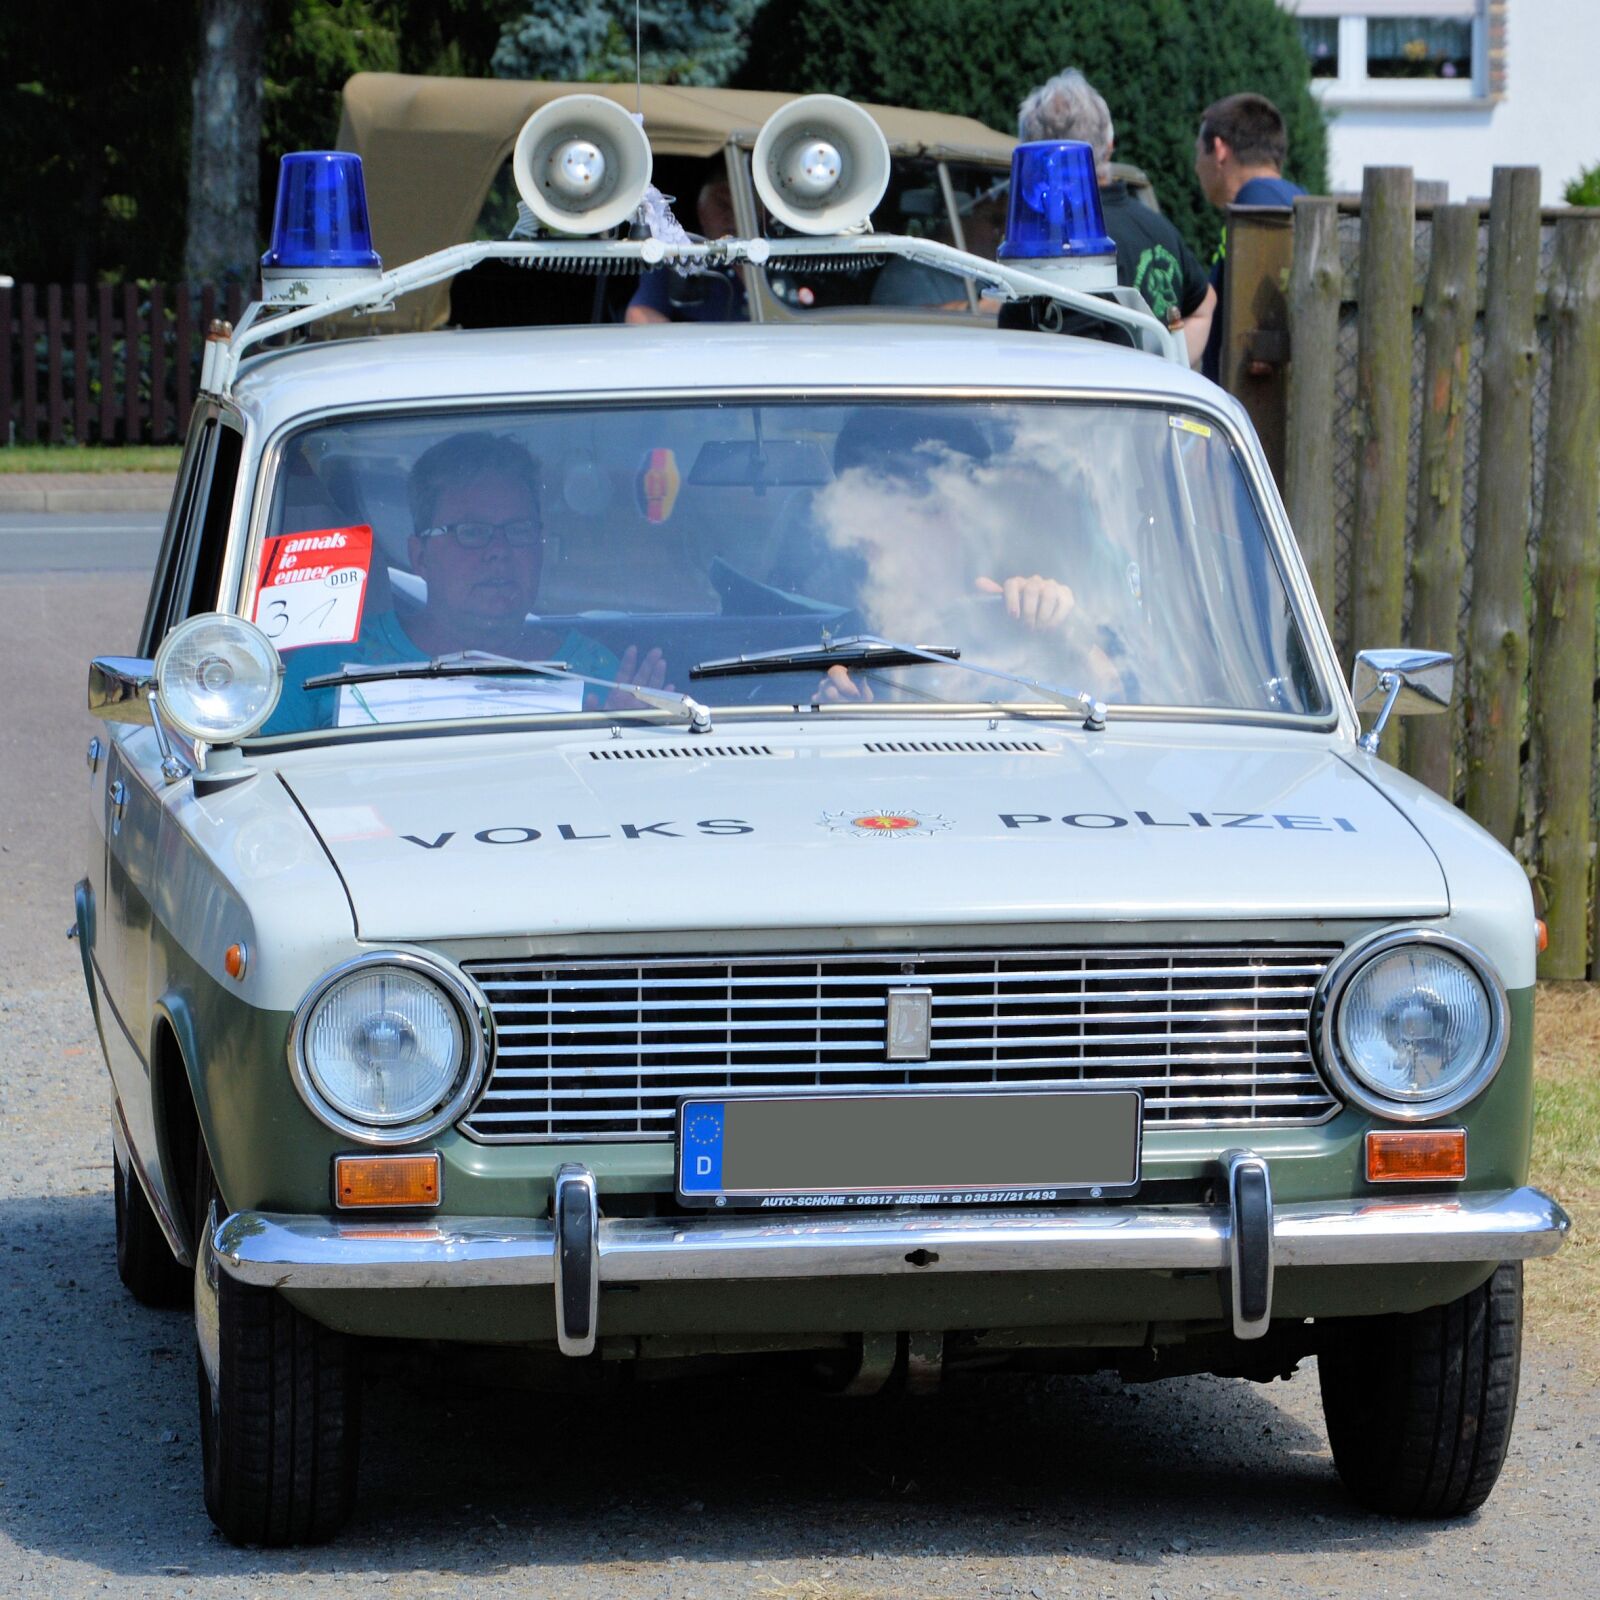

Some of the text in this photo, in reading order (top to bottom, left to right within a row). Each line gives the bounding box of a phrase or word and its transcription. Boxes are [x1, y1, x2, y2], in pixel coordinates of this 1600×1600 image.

[330, 571, 358, 586] DDR
[401, 811, 1358, 849] VOLKS POLIZEI
[696, 1156, 712, 1175] D
[761, 1195, 846, 1207] AUTO-SCHÖNE
[857, 1195, 893, 1205] 06917
[895, 1194, 940, 1205] JESSEN
